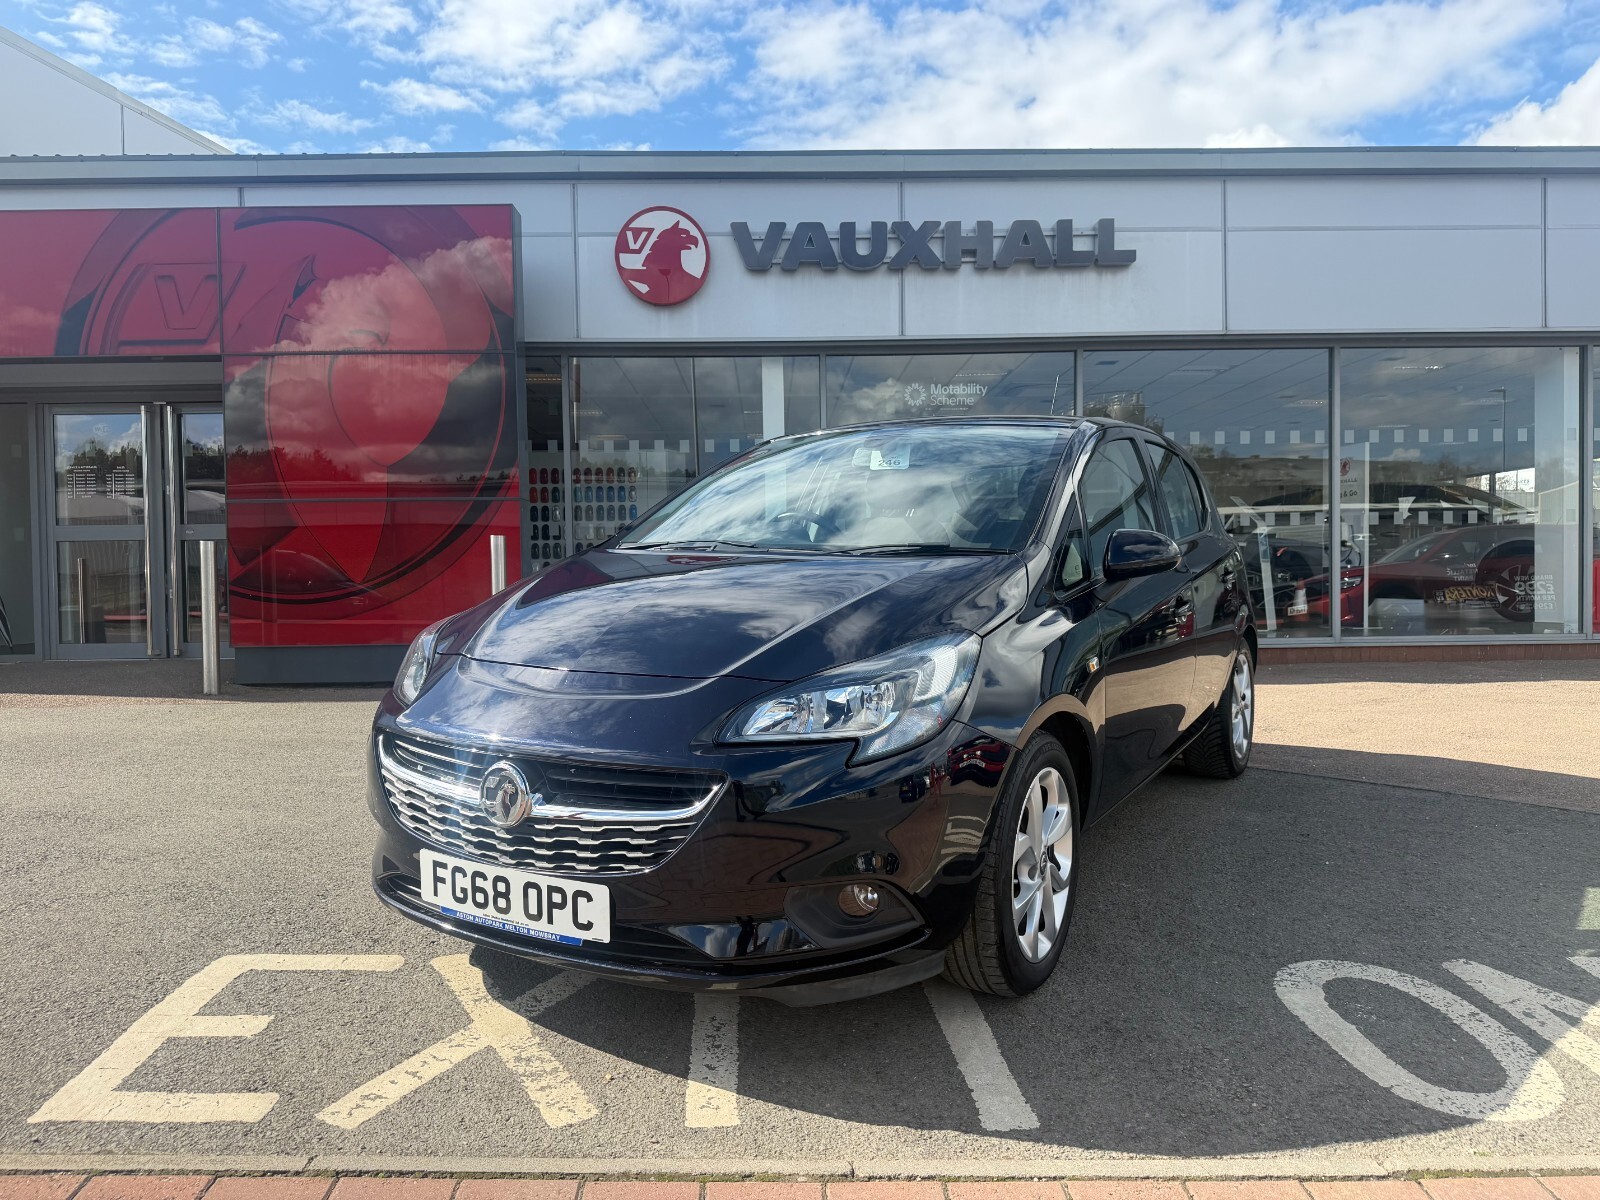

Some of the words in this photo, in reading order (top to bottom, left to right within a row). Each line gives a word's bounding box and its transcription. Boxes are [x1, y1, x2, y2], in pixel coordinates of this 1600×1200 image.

[730, 218, 1136, 271] VAUXHALL
[930, 383, 988, 397] Motability
[930, 395, 974, 406] Scheme
[432, 859, 512, 915] FG68
[522, 880, 594, 931] OPC
[456, 911, 474, 923] ASTON
[474, 915, 504, 930] AUTOPARK
[504, 923, 529, 936] MELTON
[529, 928, 561, 941] MOWBRAY
